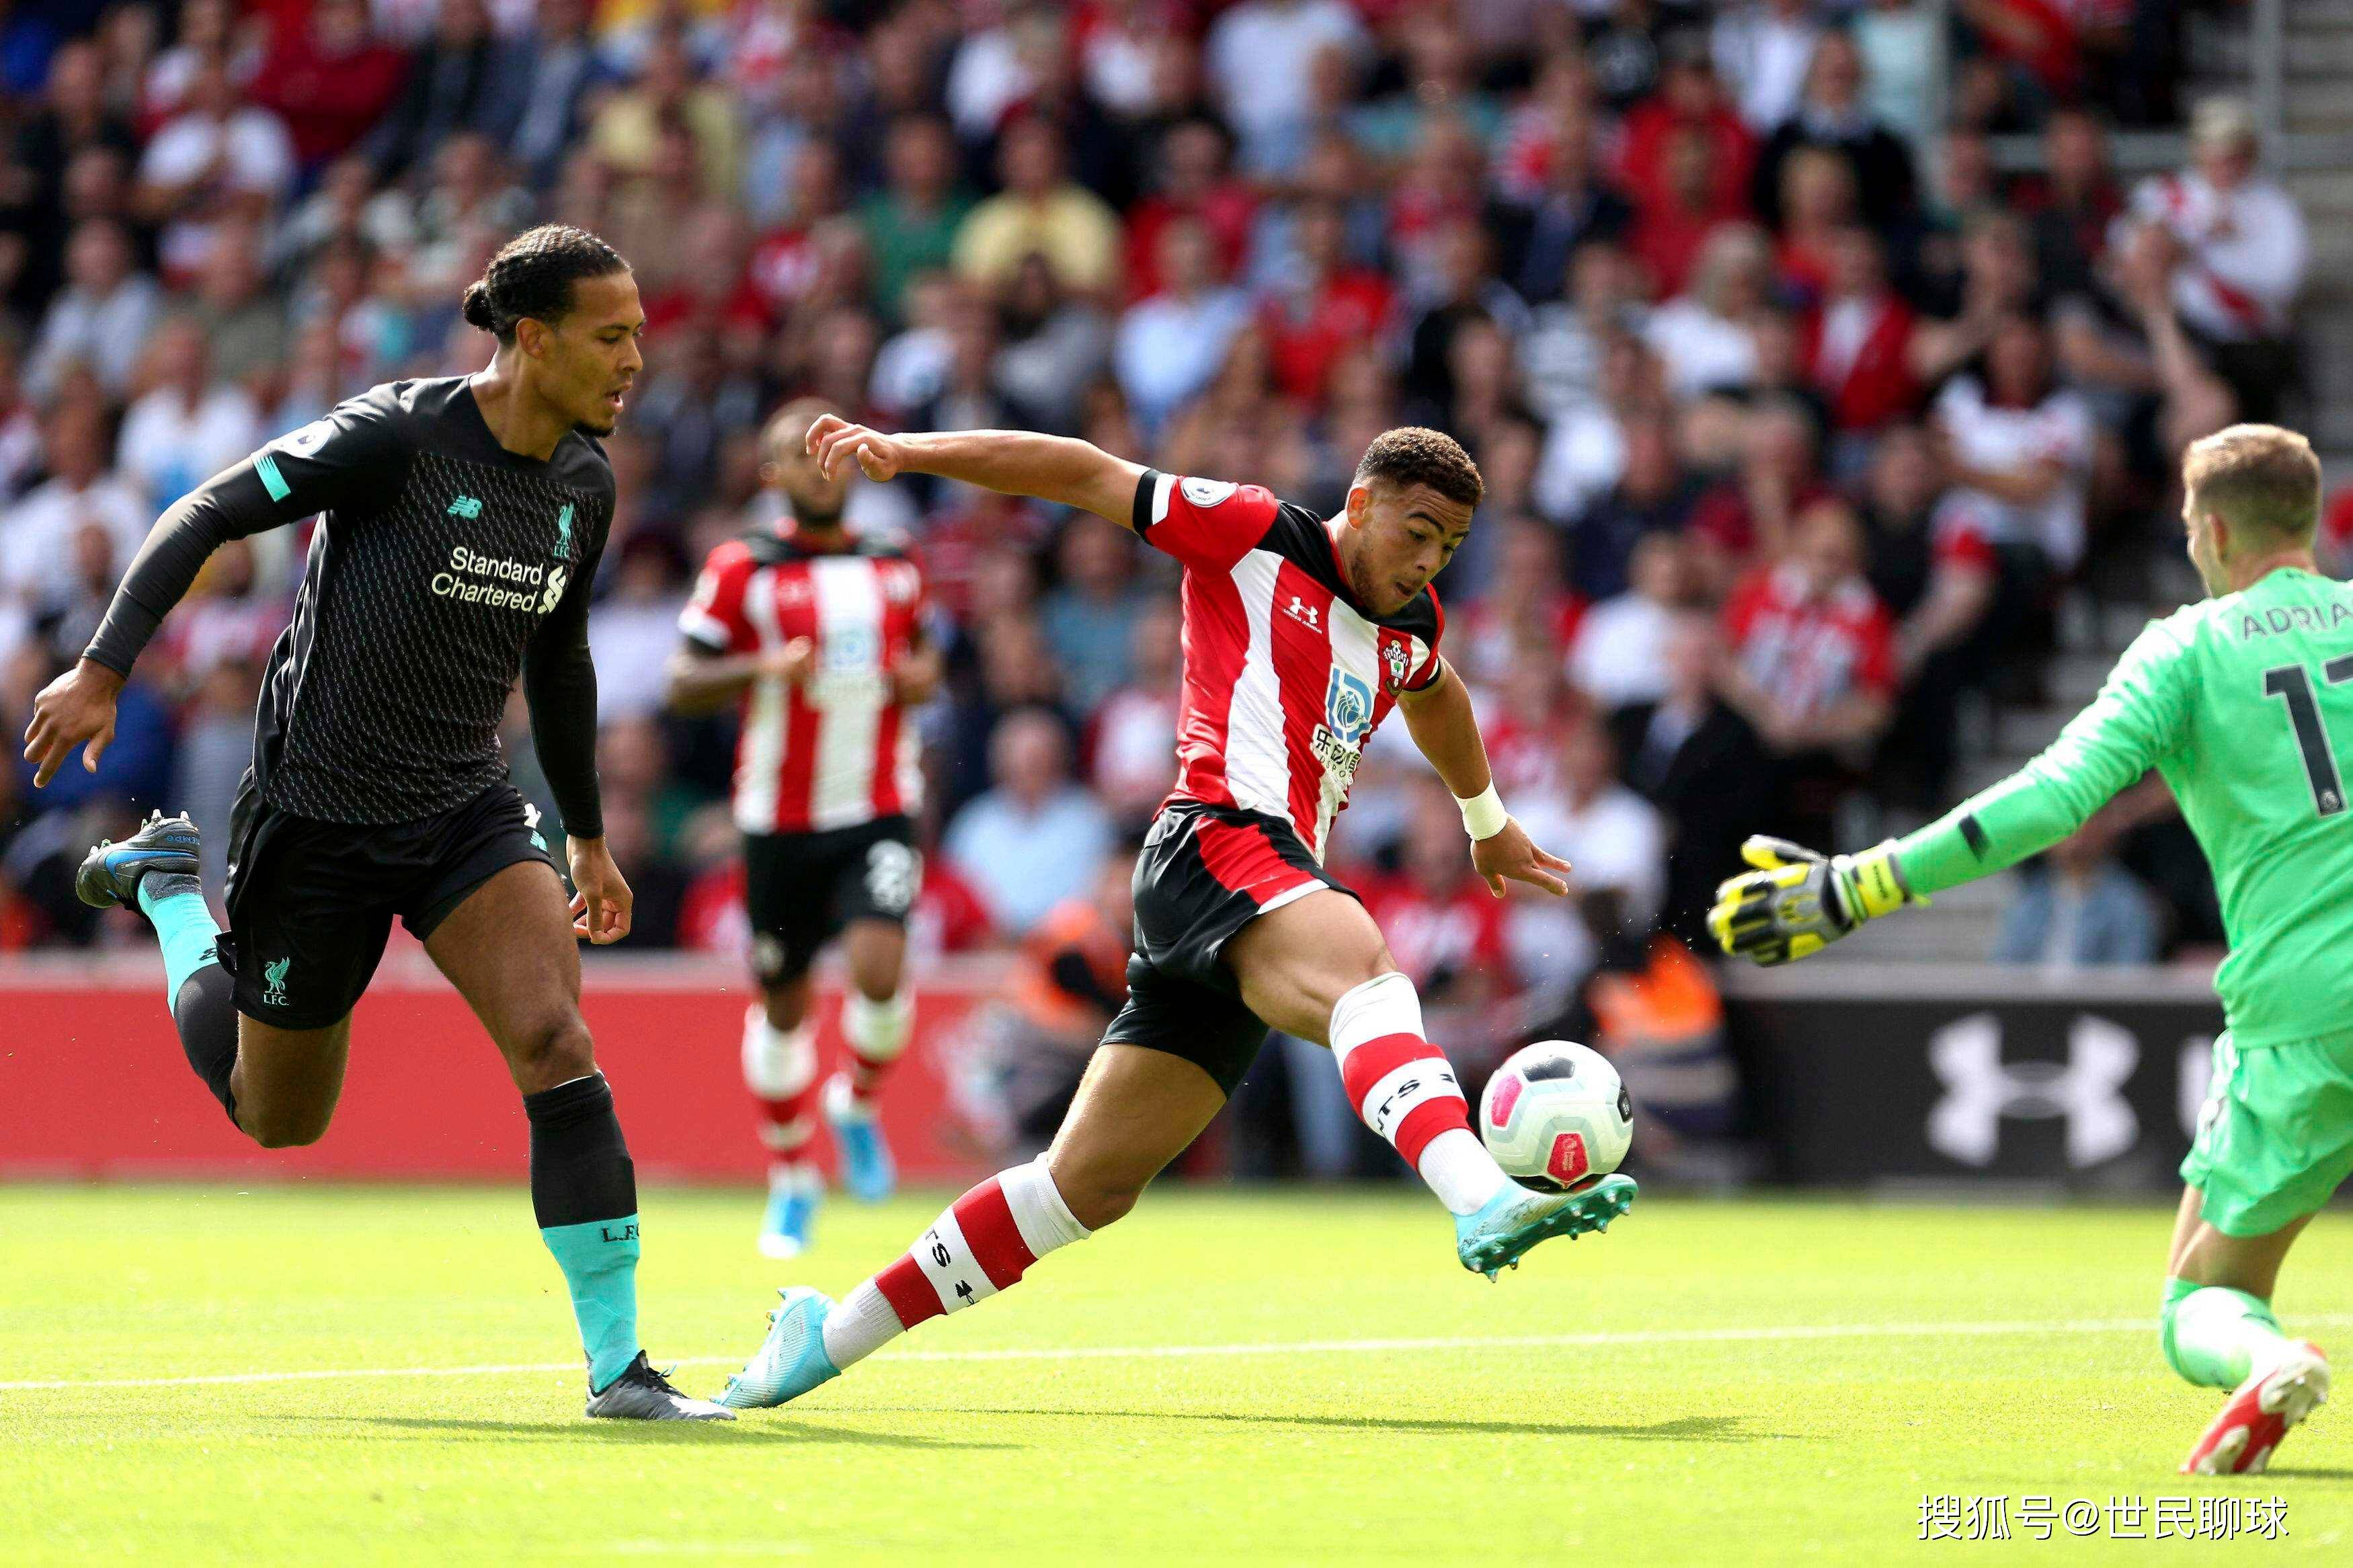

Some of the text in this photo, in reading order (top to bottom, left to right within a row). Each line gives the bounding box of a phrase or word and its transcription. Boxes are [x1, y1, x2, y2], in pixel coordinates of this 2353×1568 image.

[450, 546, 543, 585] Standard
[431, 573, 538, 612] Chartered
[1283, 608, 1302, 622] UNDER
[2243, 602, 2353, 641] ADRIA
[263, 993, 290, 1006] L.F.C.
